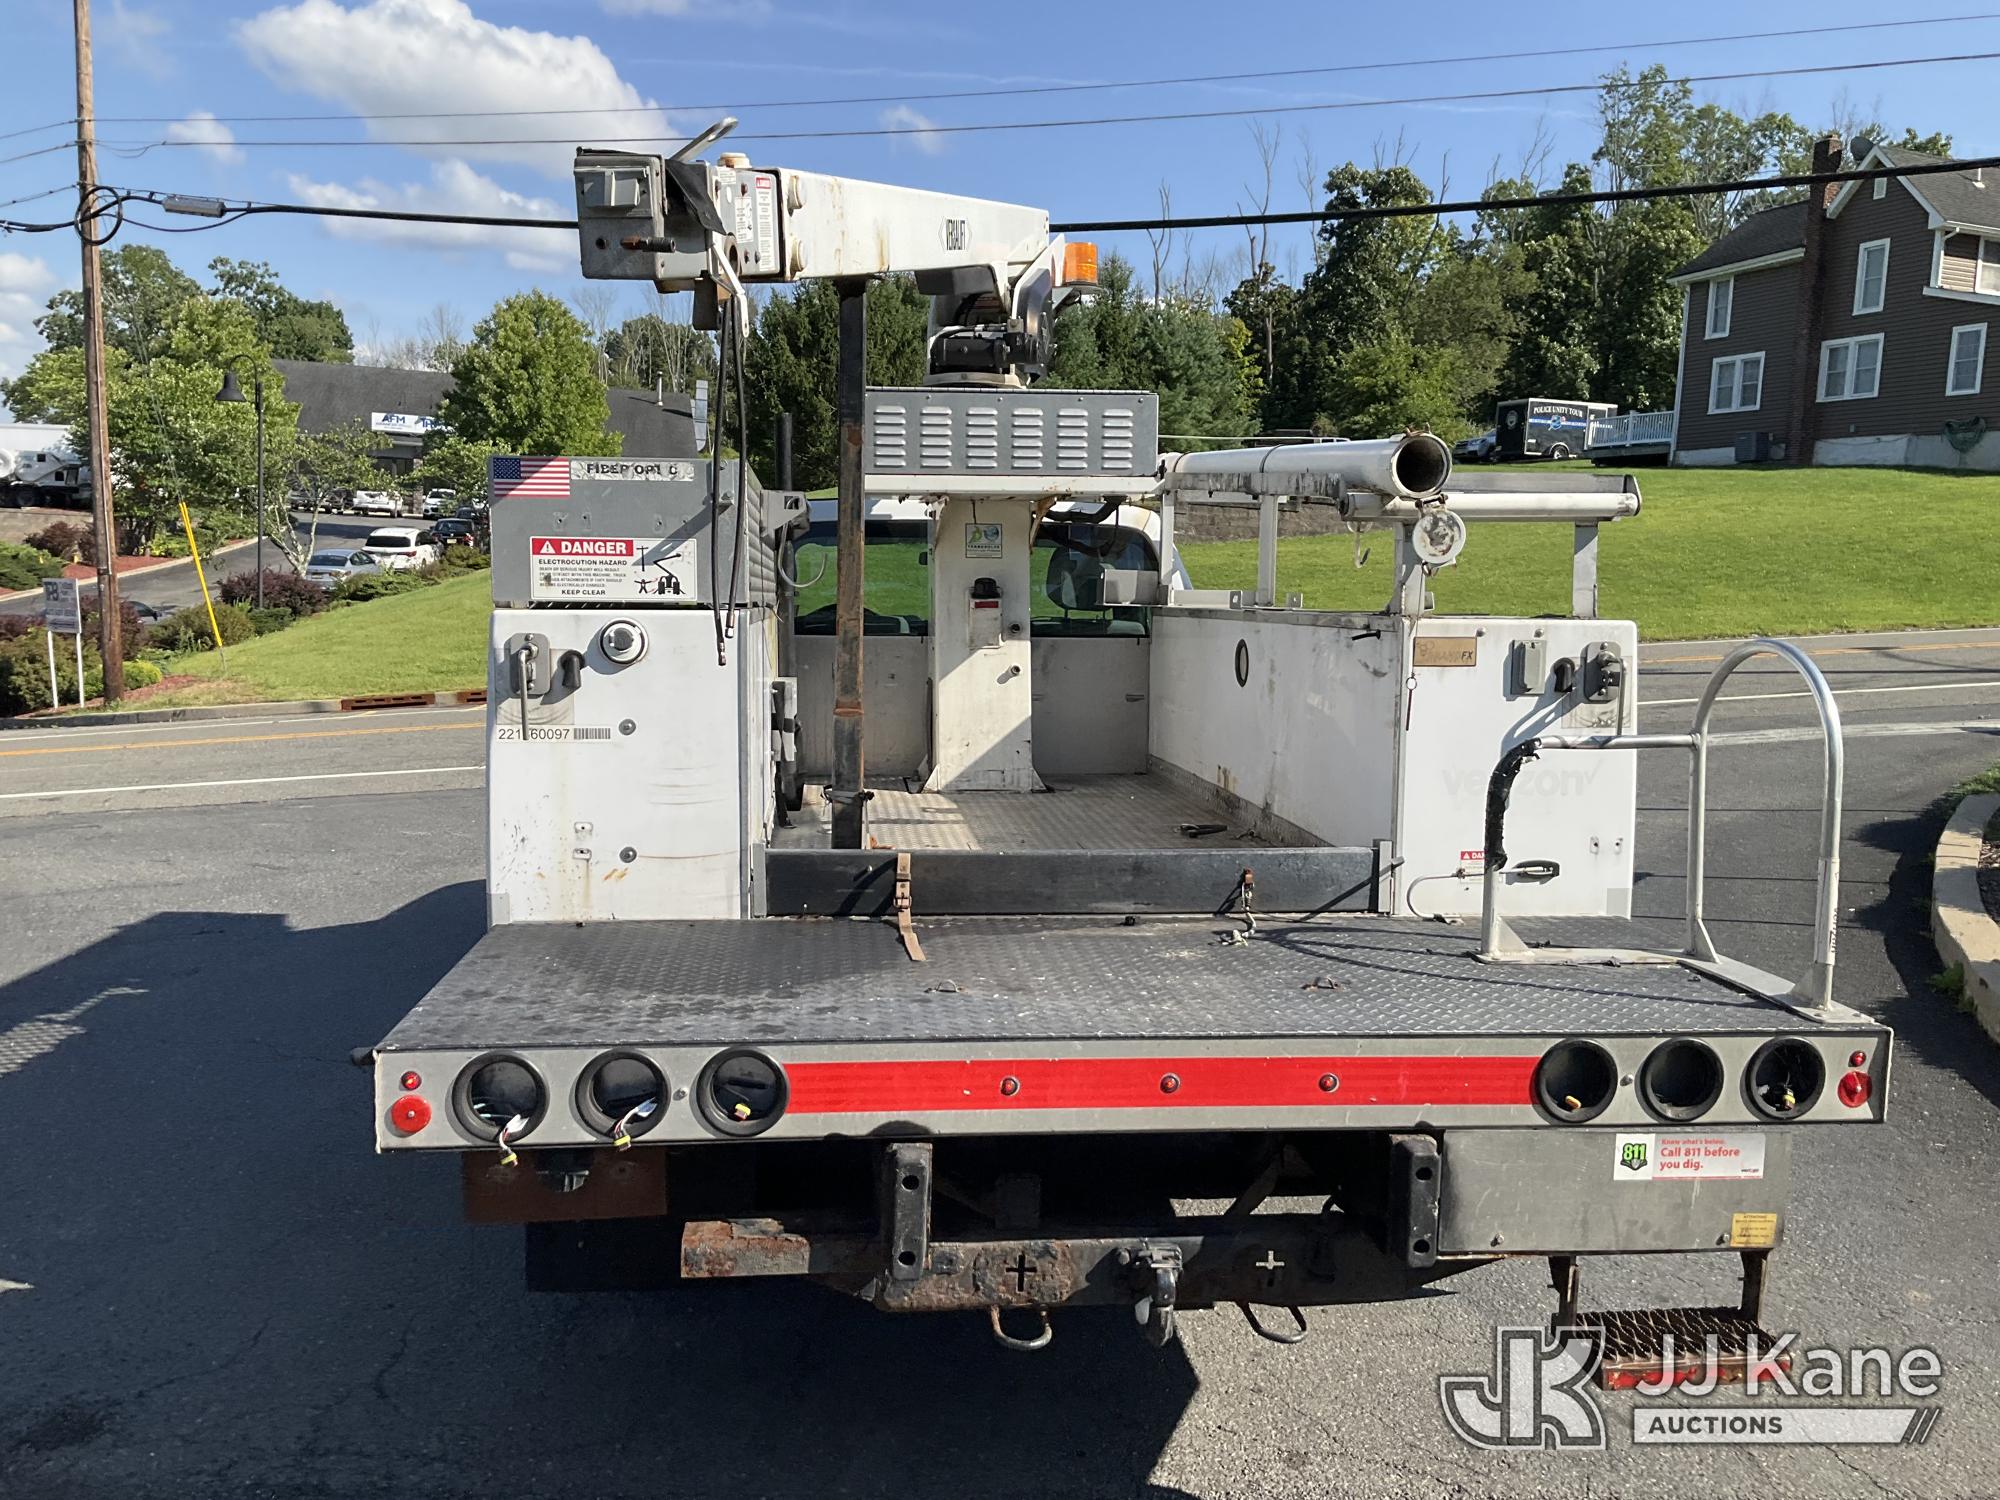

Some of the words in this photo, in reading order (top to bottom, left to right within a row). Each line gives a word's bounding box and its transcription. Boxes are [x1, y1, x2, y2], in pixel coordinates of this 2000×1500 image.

[1533, 406, 1552, 414] POLICE
[1569, 408, 1583, 418] TOUR
[382, 414, 406, 424] AFM
[561, 541, 626, 554] DANGER
[498, 728, 570, 740] 22160097
[1623, 1144, 1647, 1160] 811
[1660, 1148, 1680, 1157] Call
[1684, 1148, 1701, 1157] 811
[1704, 1147, 1740, 1157] before
[1660, 1160, 1680, 1171] you
[1683, 1159, 1703, 1171] dig.
